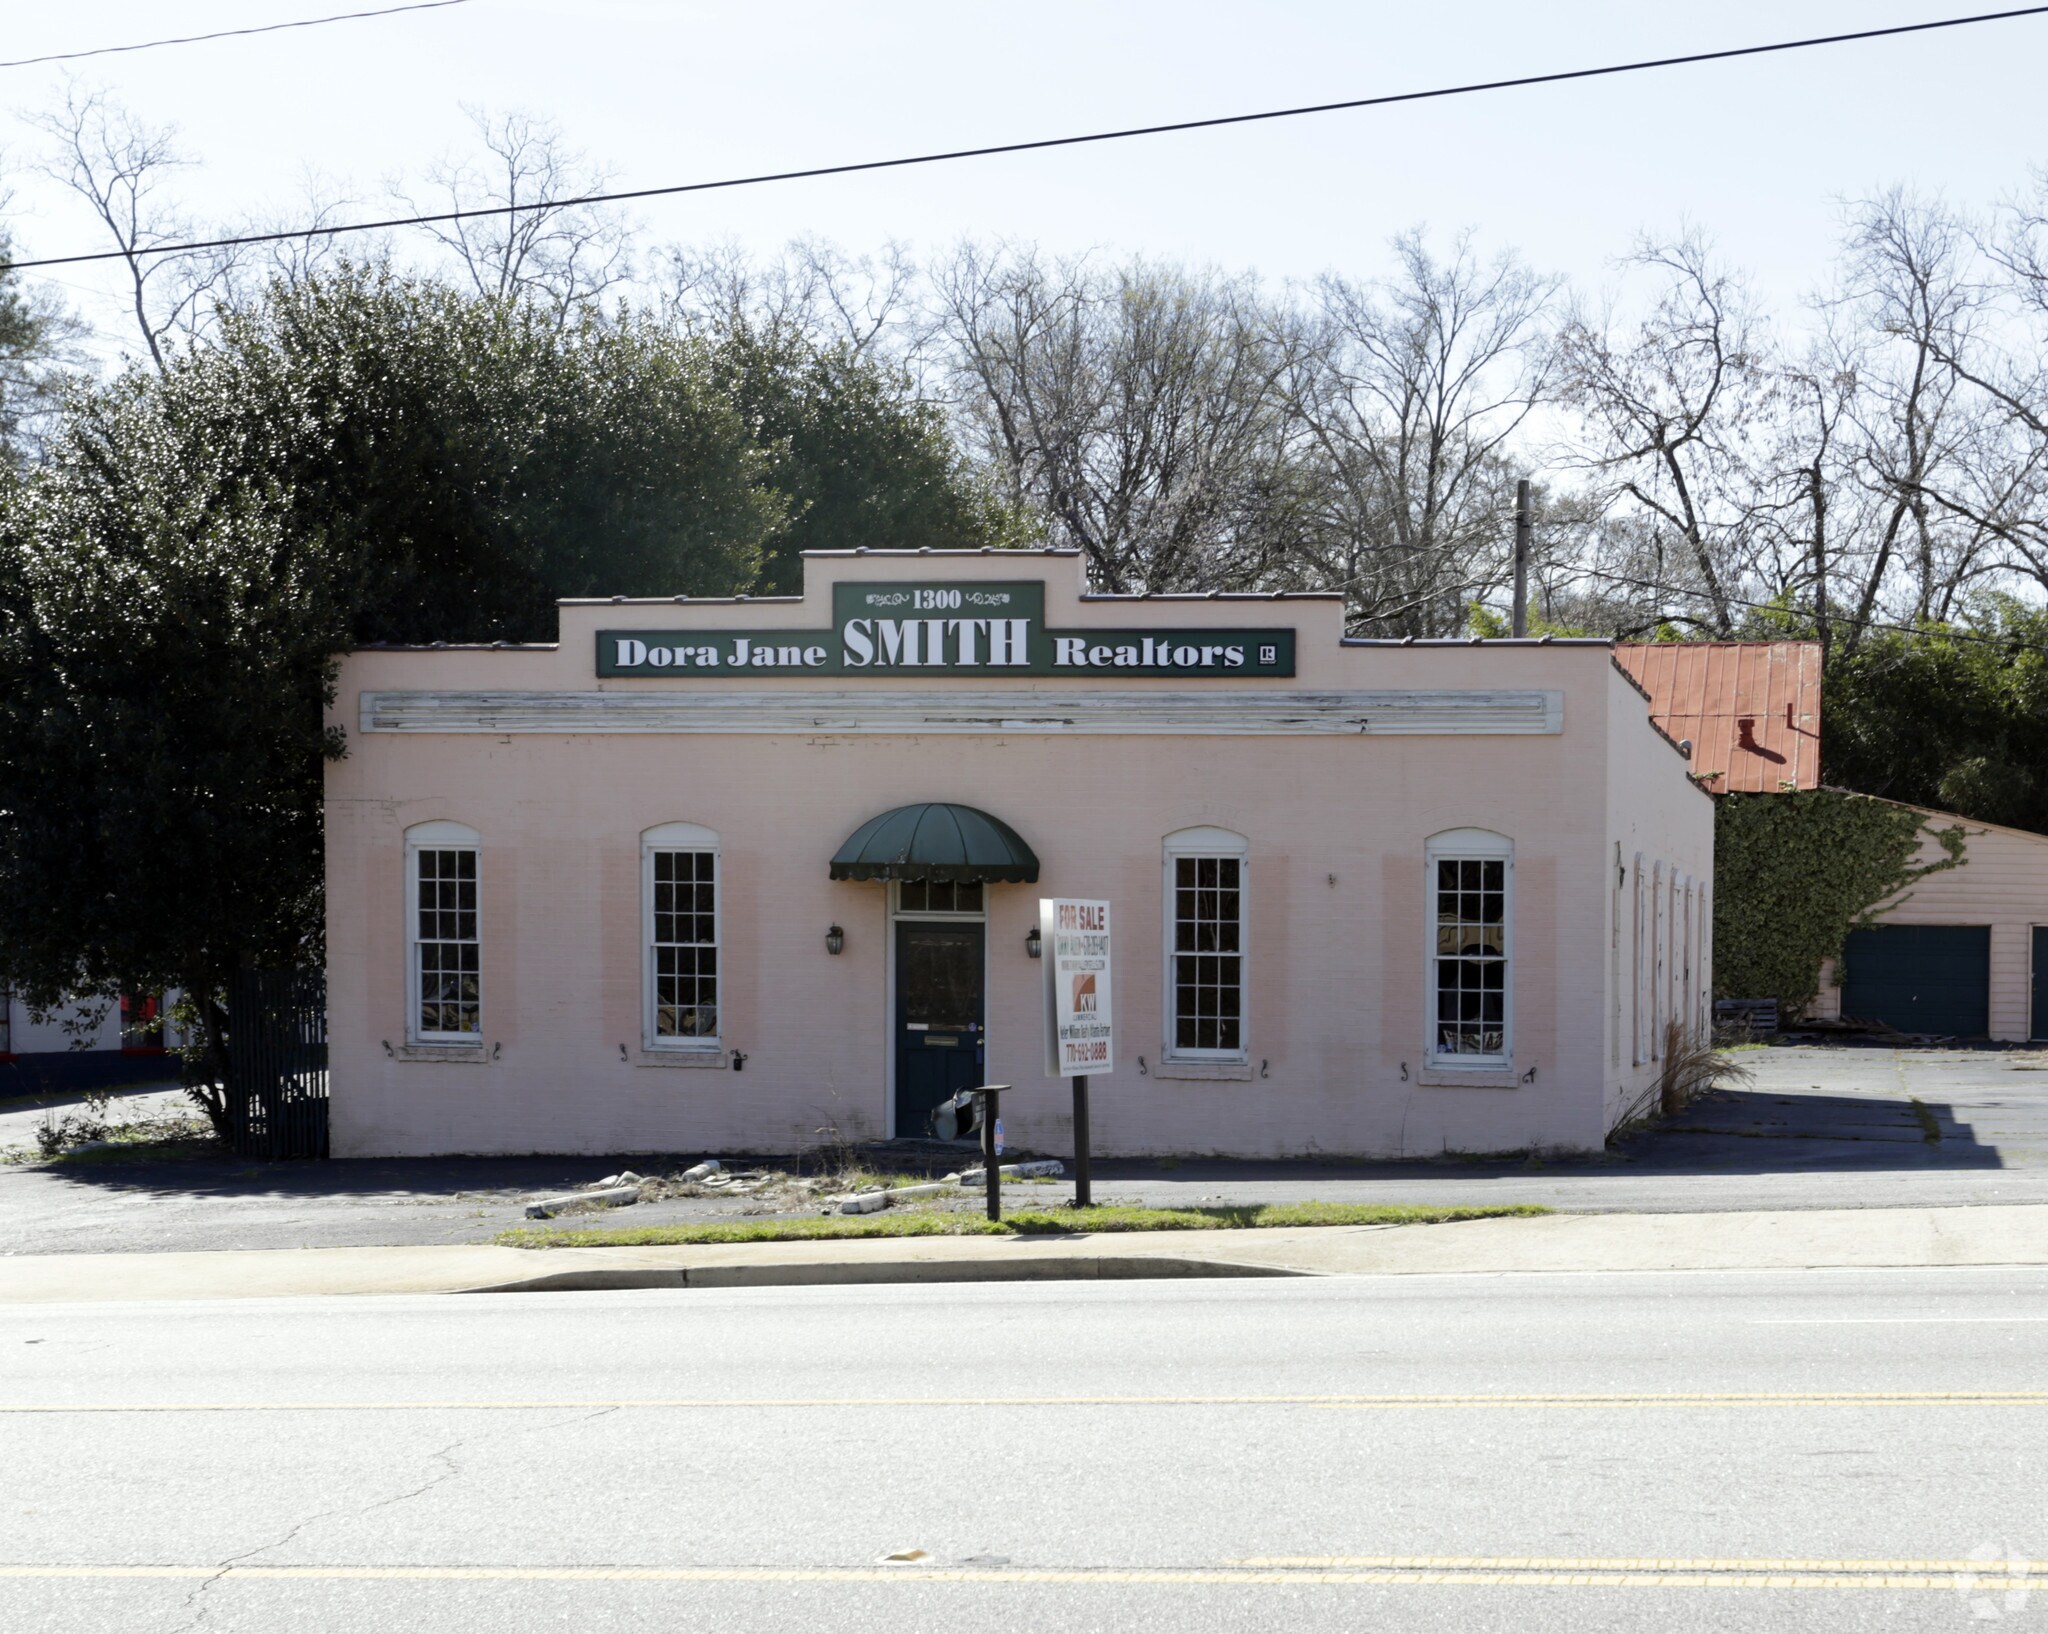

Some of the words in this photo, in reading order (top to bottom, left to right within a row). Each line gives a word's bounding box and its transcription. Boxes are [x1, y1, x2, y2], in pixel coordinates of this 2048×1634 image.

[912, 589, 962, 610] 1300
[615, 639, 720, 667] Dora
[727, 638, 827, 667] Jane
[843, 618, 1031, 667] SMITH
[1053, 637, 1245, 667] Realtors
[1059, 904, 1077, 930] FOR
[1079, 905, 1104, 930] SALE
